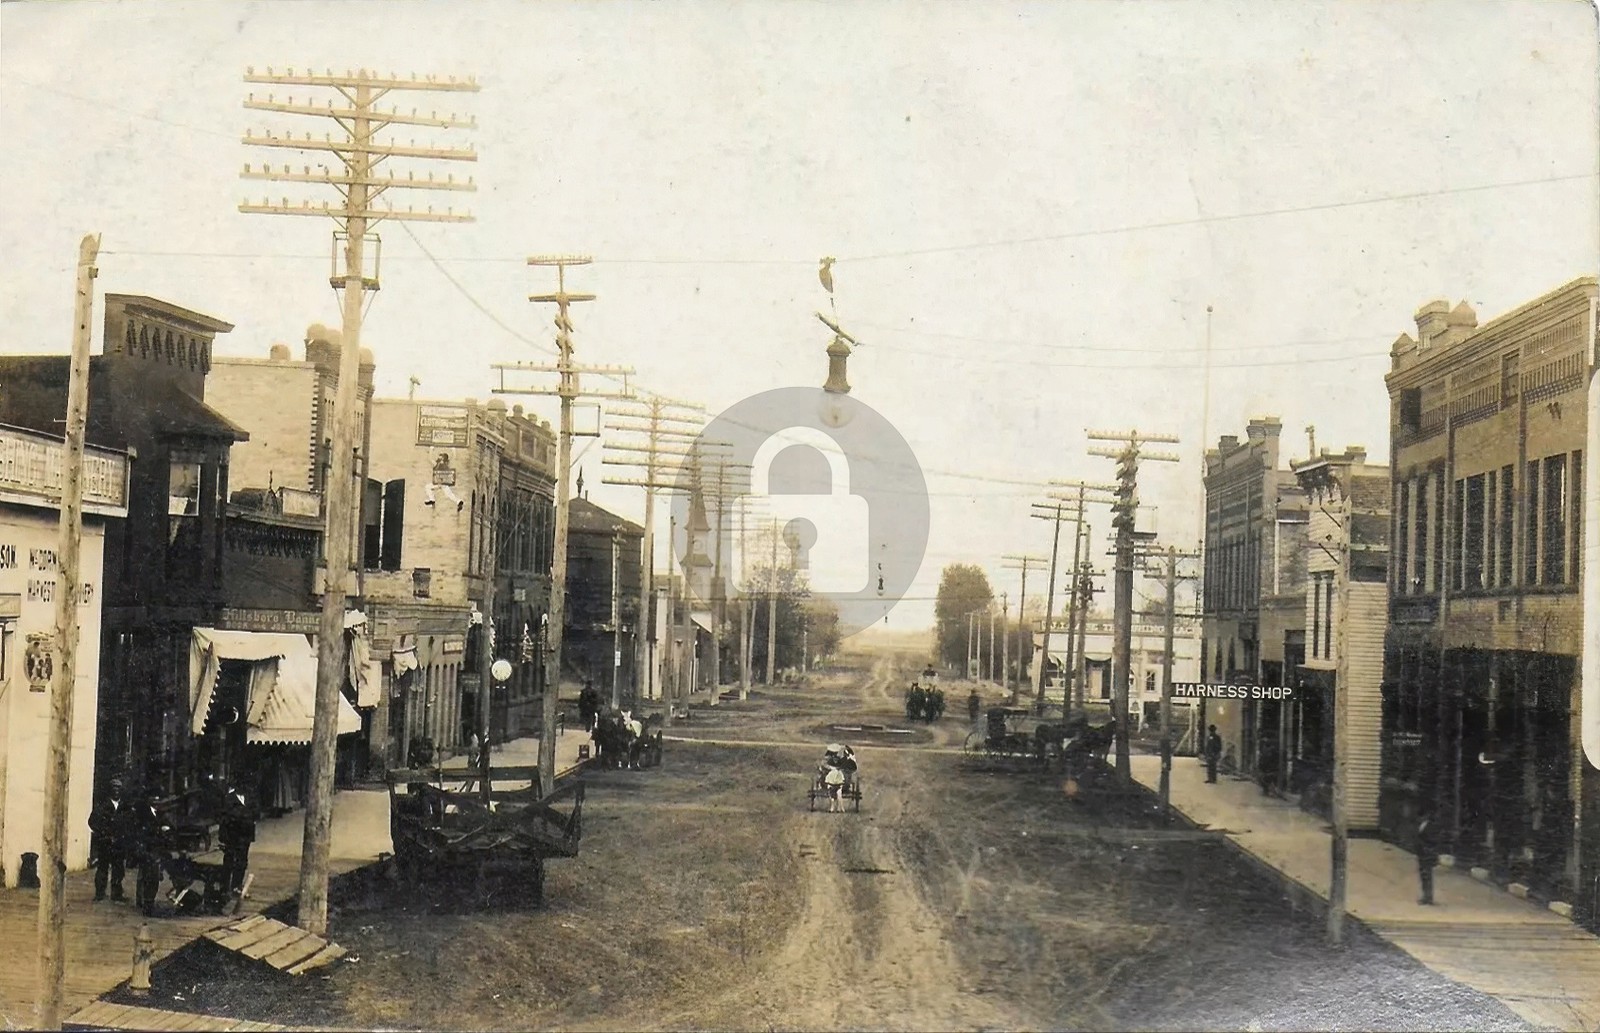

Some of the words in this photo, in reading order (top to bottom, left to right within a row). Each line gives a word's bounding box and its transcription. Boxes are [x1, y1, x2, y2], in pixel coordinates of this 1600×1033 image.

[284, 611, 320, 624] Banne
[1175, 683, 1248, 699] HARNESS
[1251, 686, 1292, 700] SHOP
